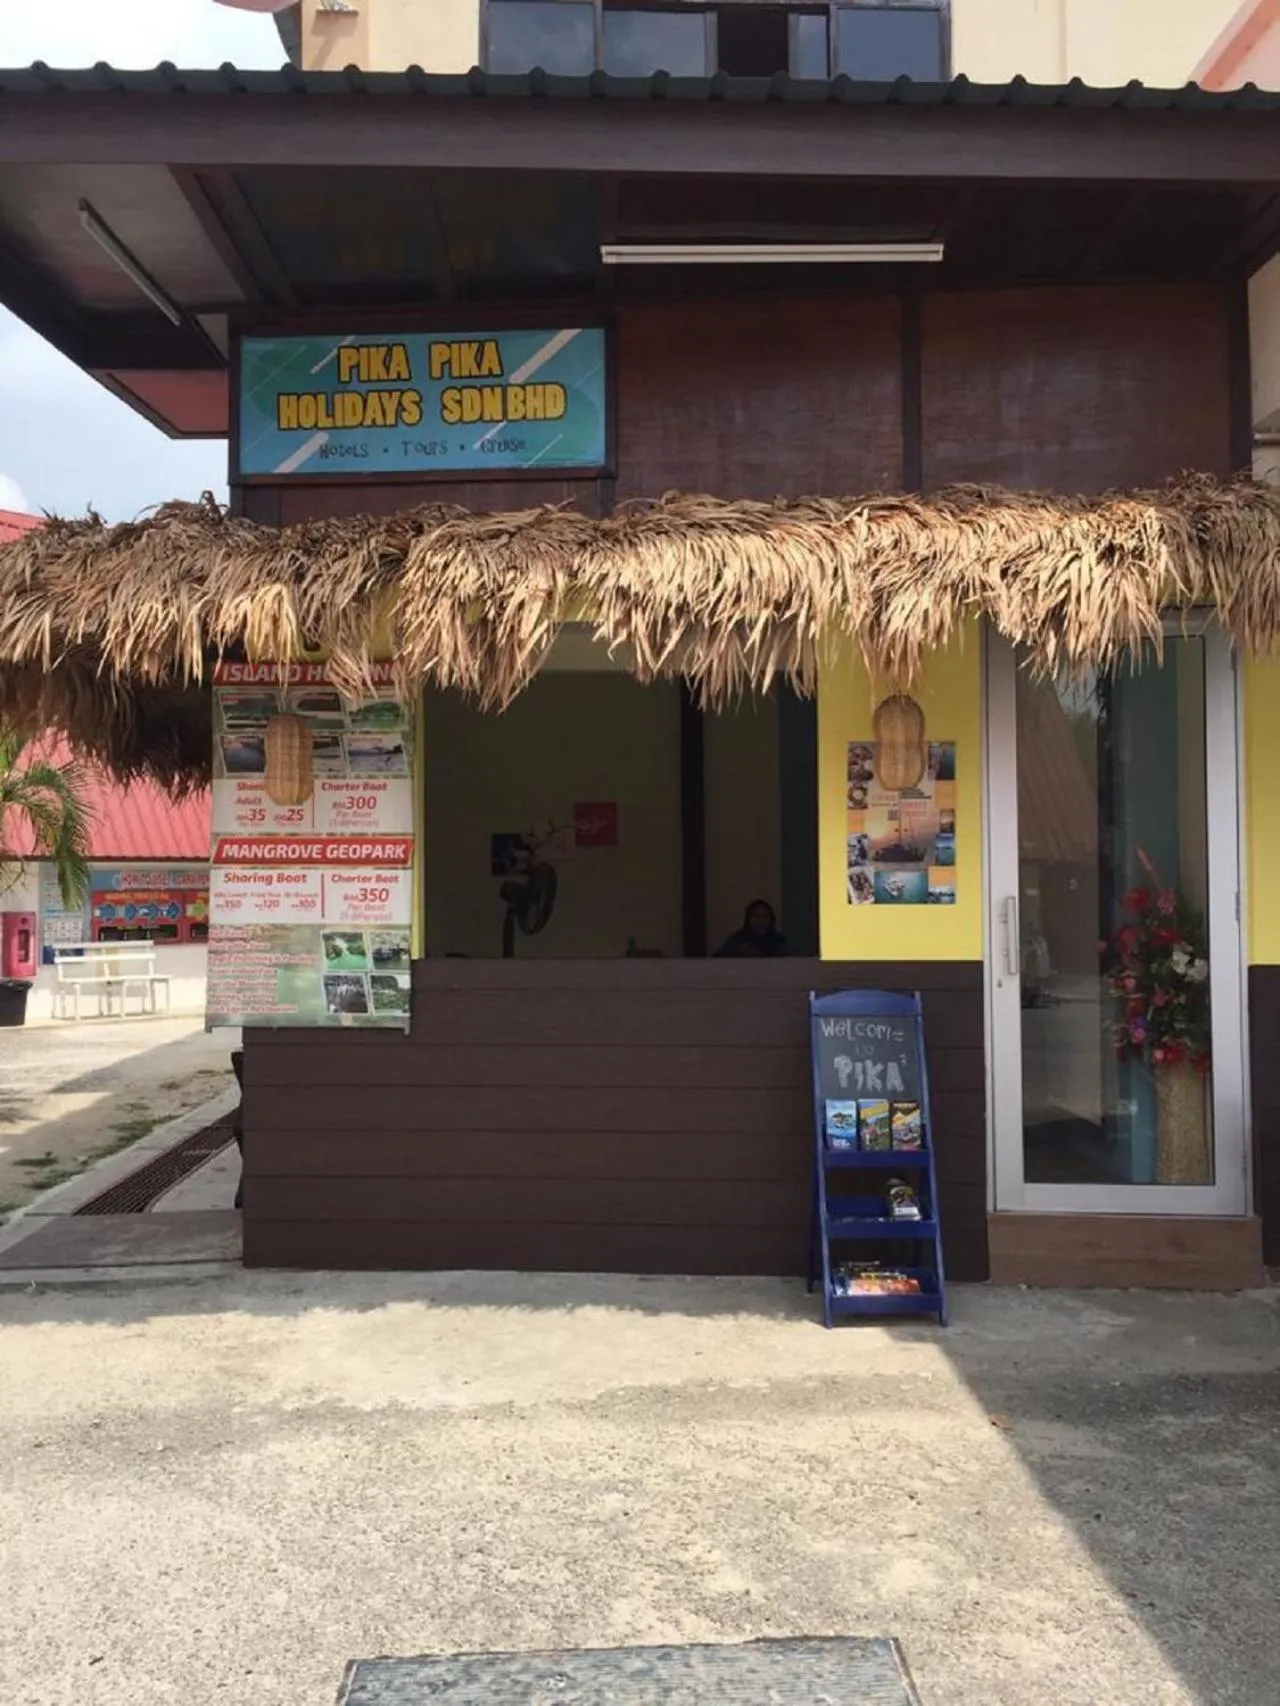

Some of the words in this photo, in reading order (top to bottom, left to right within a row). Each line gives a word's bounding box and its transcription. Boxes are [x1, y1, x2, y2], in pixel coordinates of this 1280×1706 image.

[338, 342, 411, 383] PIKA
[429, 339, 502, 380] PIKA
[277, 389, 422, 431] HOLIDAYS
[440, 386, 505, 424] SDN
[502, 382, 567, 421] BHD
[223, 664, 301, 682] ISLAND
[321, 782, 360, 791] Charter
[362, 782, 387, 791] Boat
[222, 844, 322, 859] MANGROVE
[326, 844, 406, 859] GEOPARK
[224, 872, 273, 885] Sharing
[277, 873, 307, 883] Boat
[331, 874, 372, 884] Charter
[375, 874, 399, 884] Boat
[820, 1018, 905, 1042] Welcome
